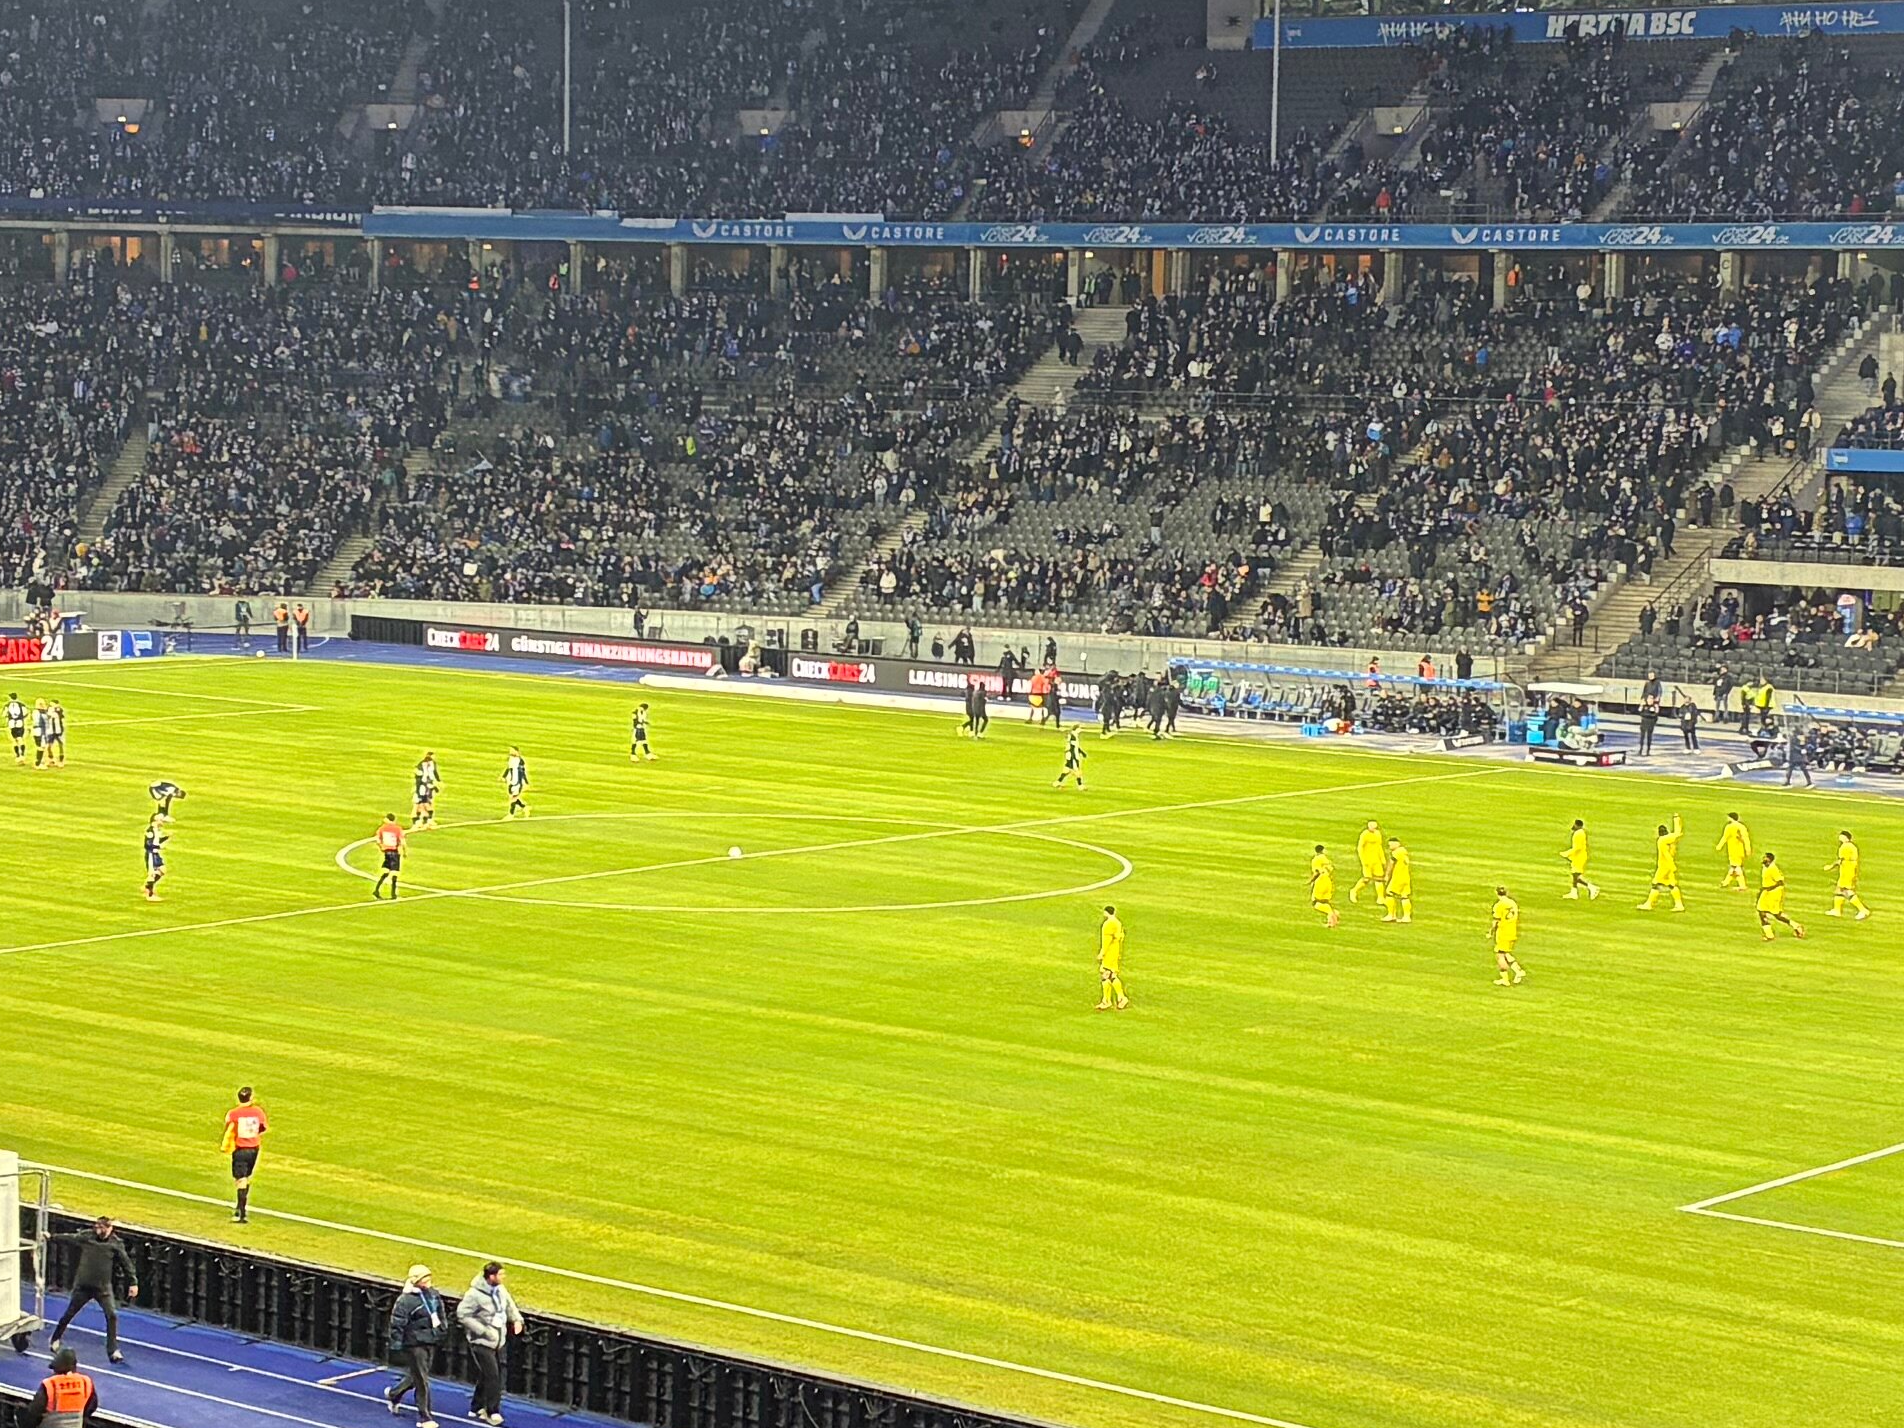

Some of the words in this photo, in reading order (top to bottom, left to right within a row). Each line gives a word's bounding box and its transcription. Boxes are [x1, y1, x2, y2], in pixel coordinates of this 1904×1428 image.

[1649, 10, 1697, 35] BSC
[720, 224, 794, 237] CASTORE
[871, 226, 945, 239] CASTORE
[1324, 228, 1401, 242] CASTORE
[1482, 229, 1561, 242] CASTORE
[909, 669, 968, 690] LEASING
